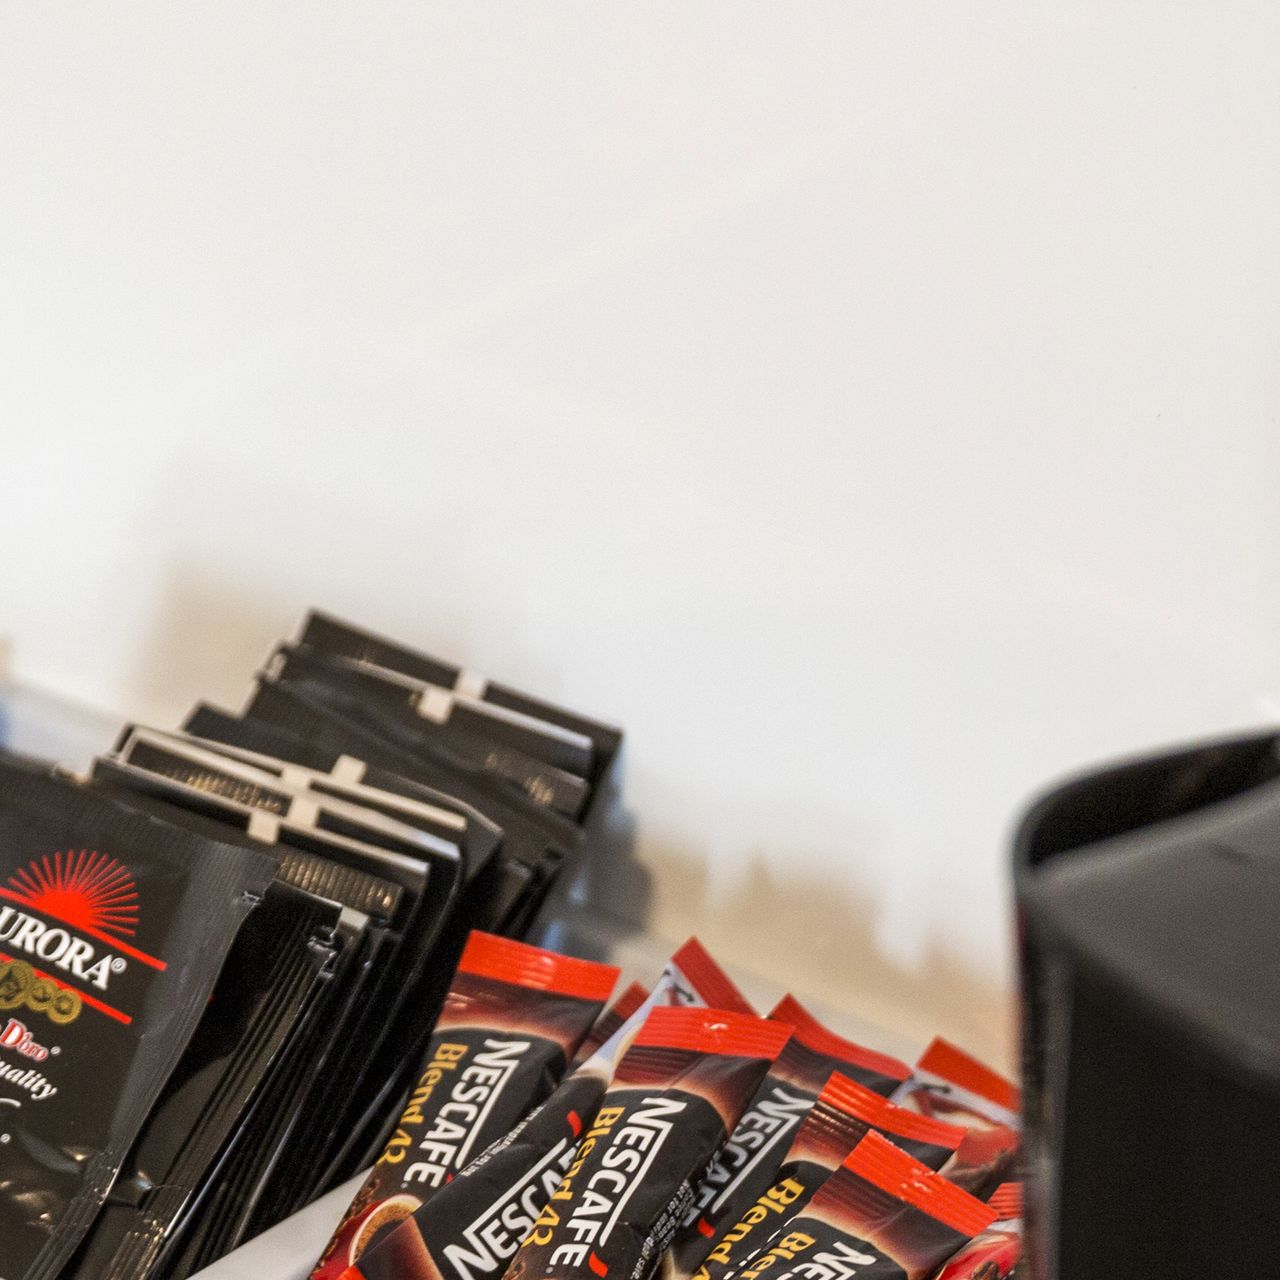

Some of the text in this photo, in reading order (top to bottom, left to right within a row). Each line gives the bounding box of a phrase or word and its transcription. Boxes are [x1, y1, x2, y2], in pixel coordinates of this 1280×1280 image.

[400, 1043, 468, 1124] Blend
[551, 1107, 625, 1200] Blend
[641, 1213, 668, 1259] inddual
[704, 1177, 806, 1265] Blend
